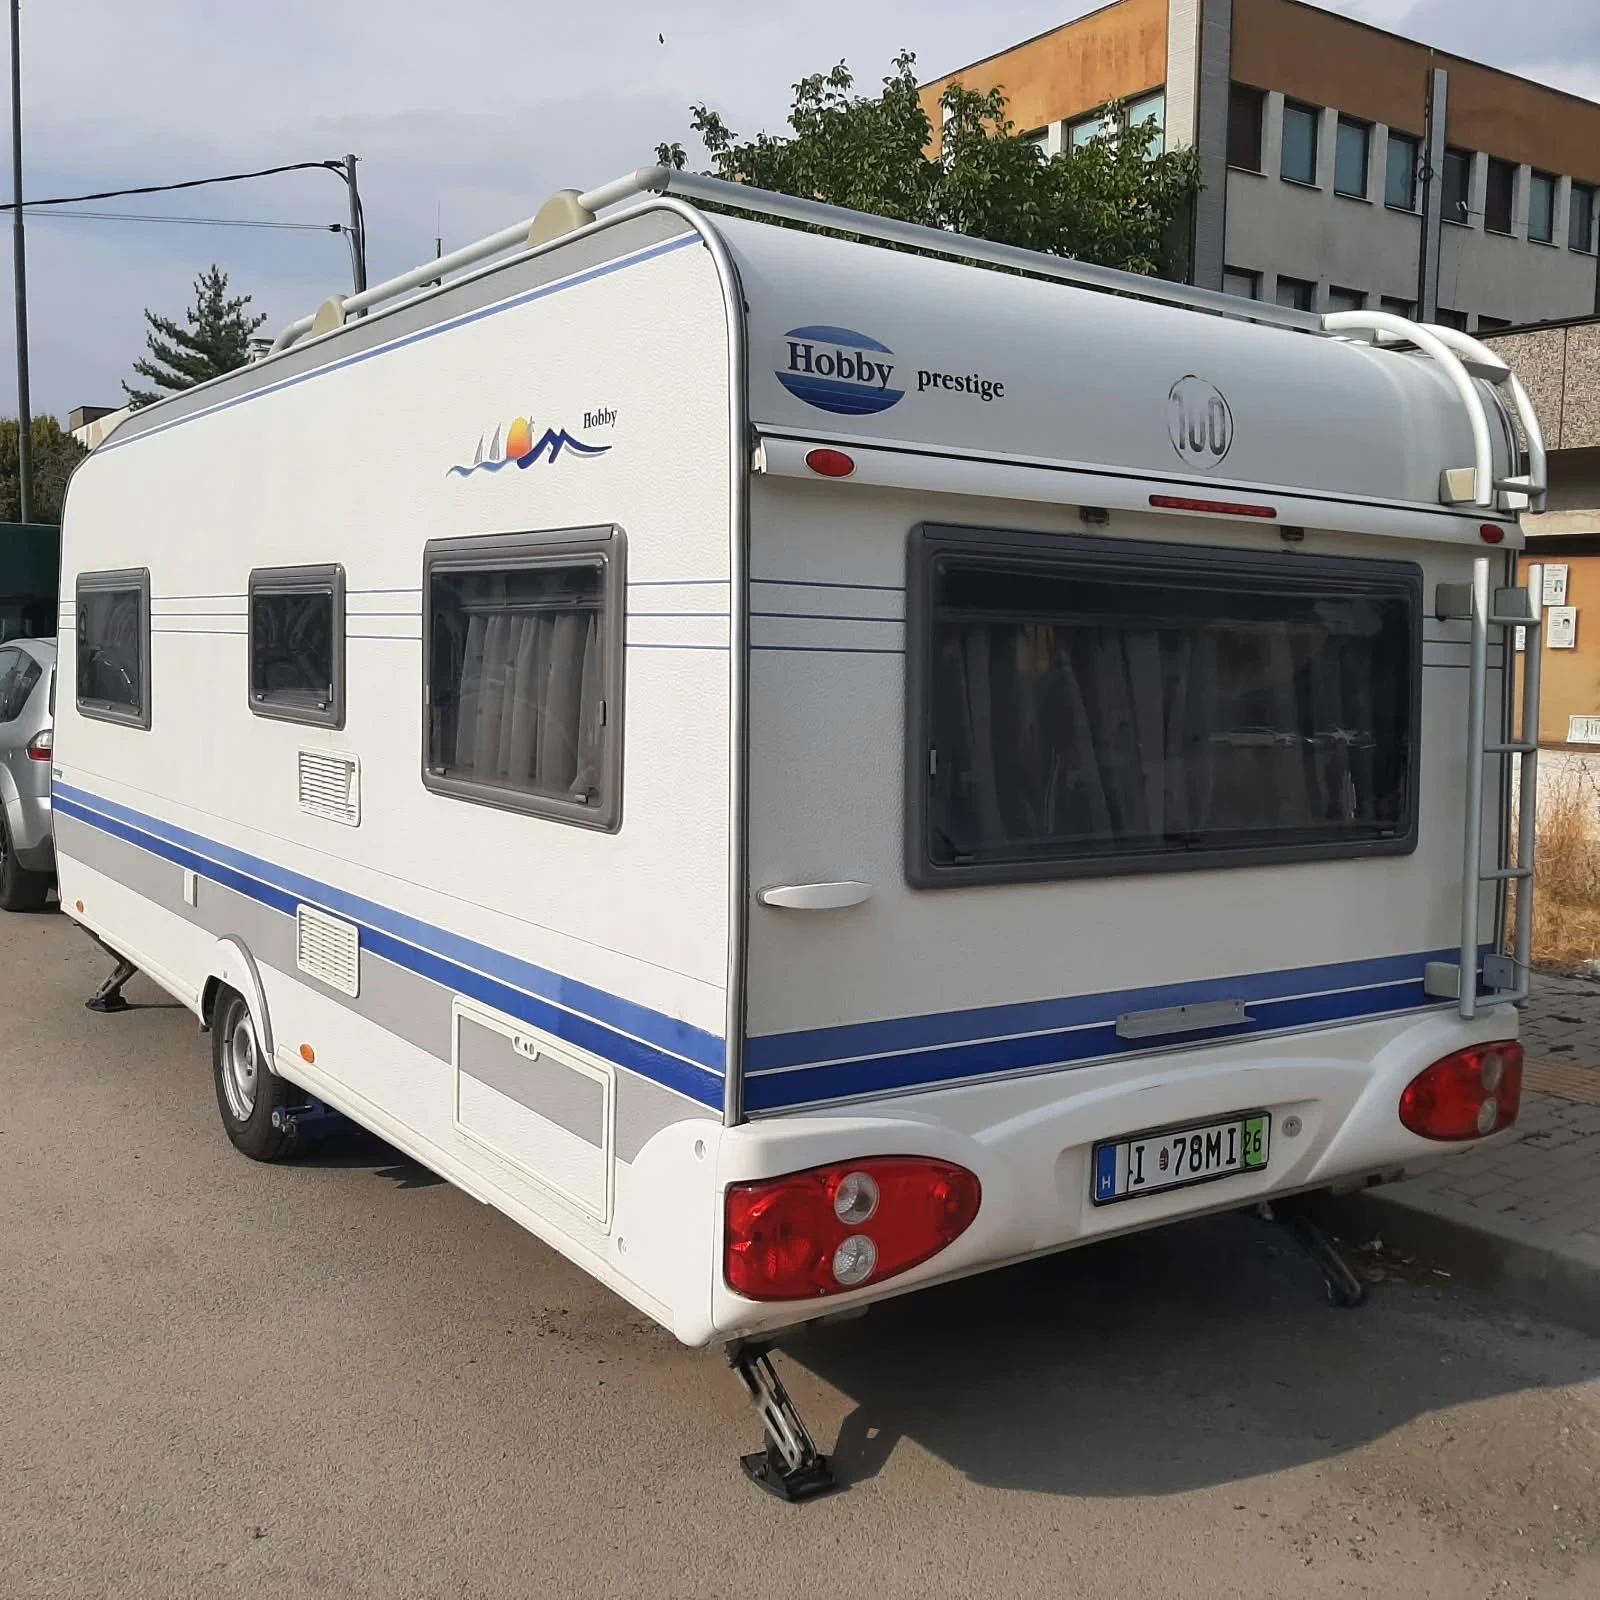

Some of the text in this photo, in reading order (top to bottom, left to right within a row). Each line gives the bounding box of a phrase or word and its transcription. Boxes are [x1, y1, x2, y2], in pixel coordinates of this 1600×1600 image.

[787, 341, 1005, 401] Hobby prestige
[583, 407, 618, 429] Hobby
[1102, 1175, 1111, 1191] H
